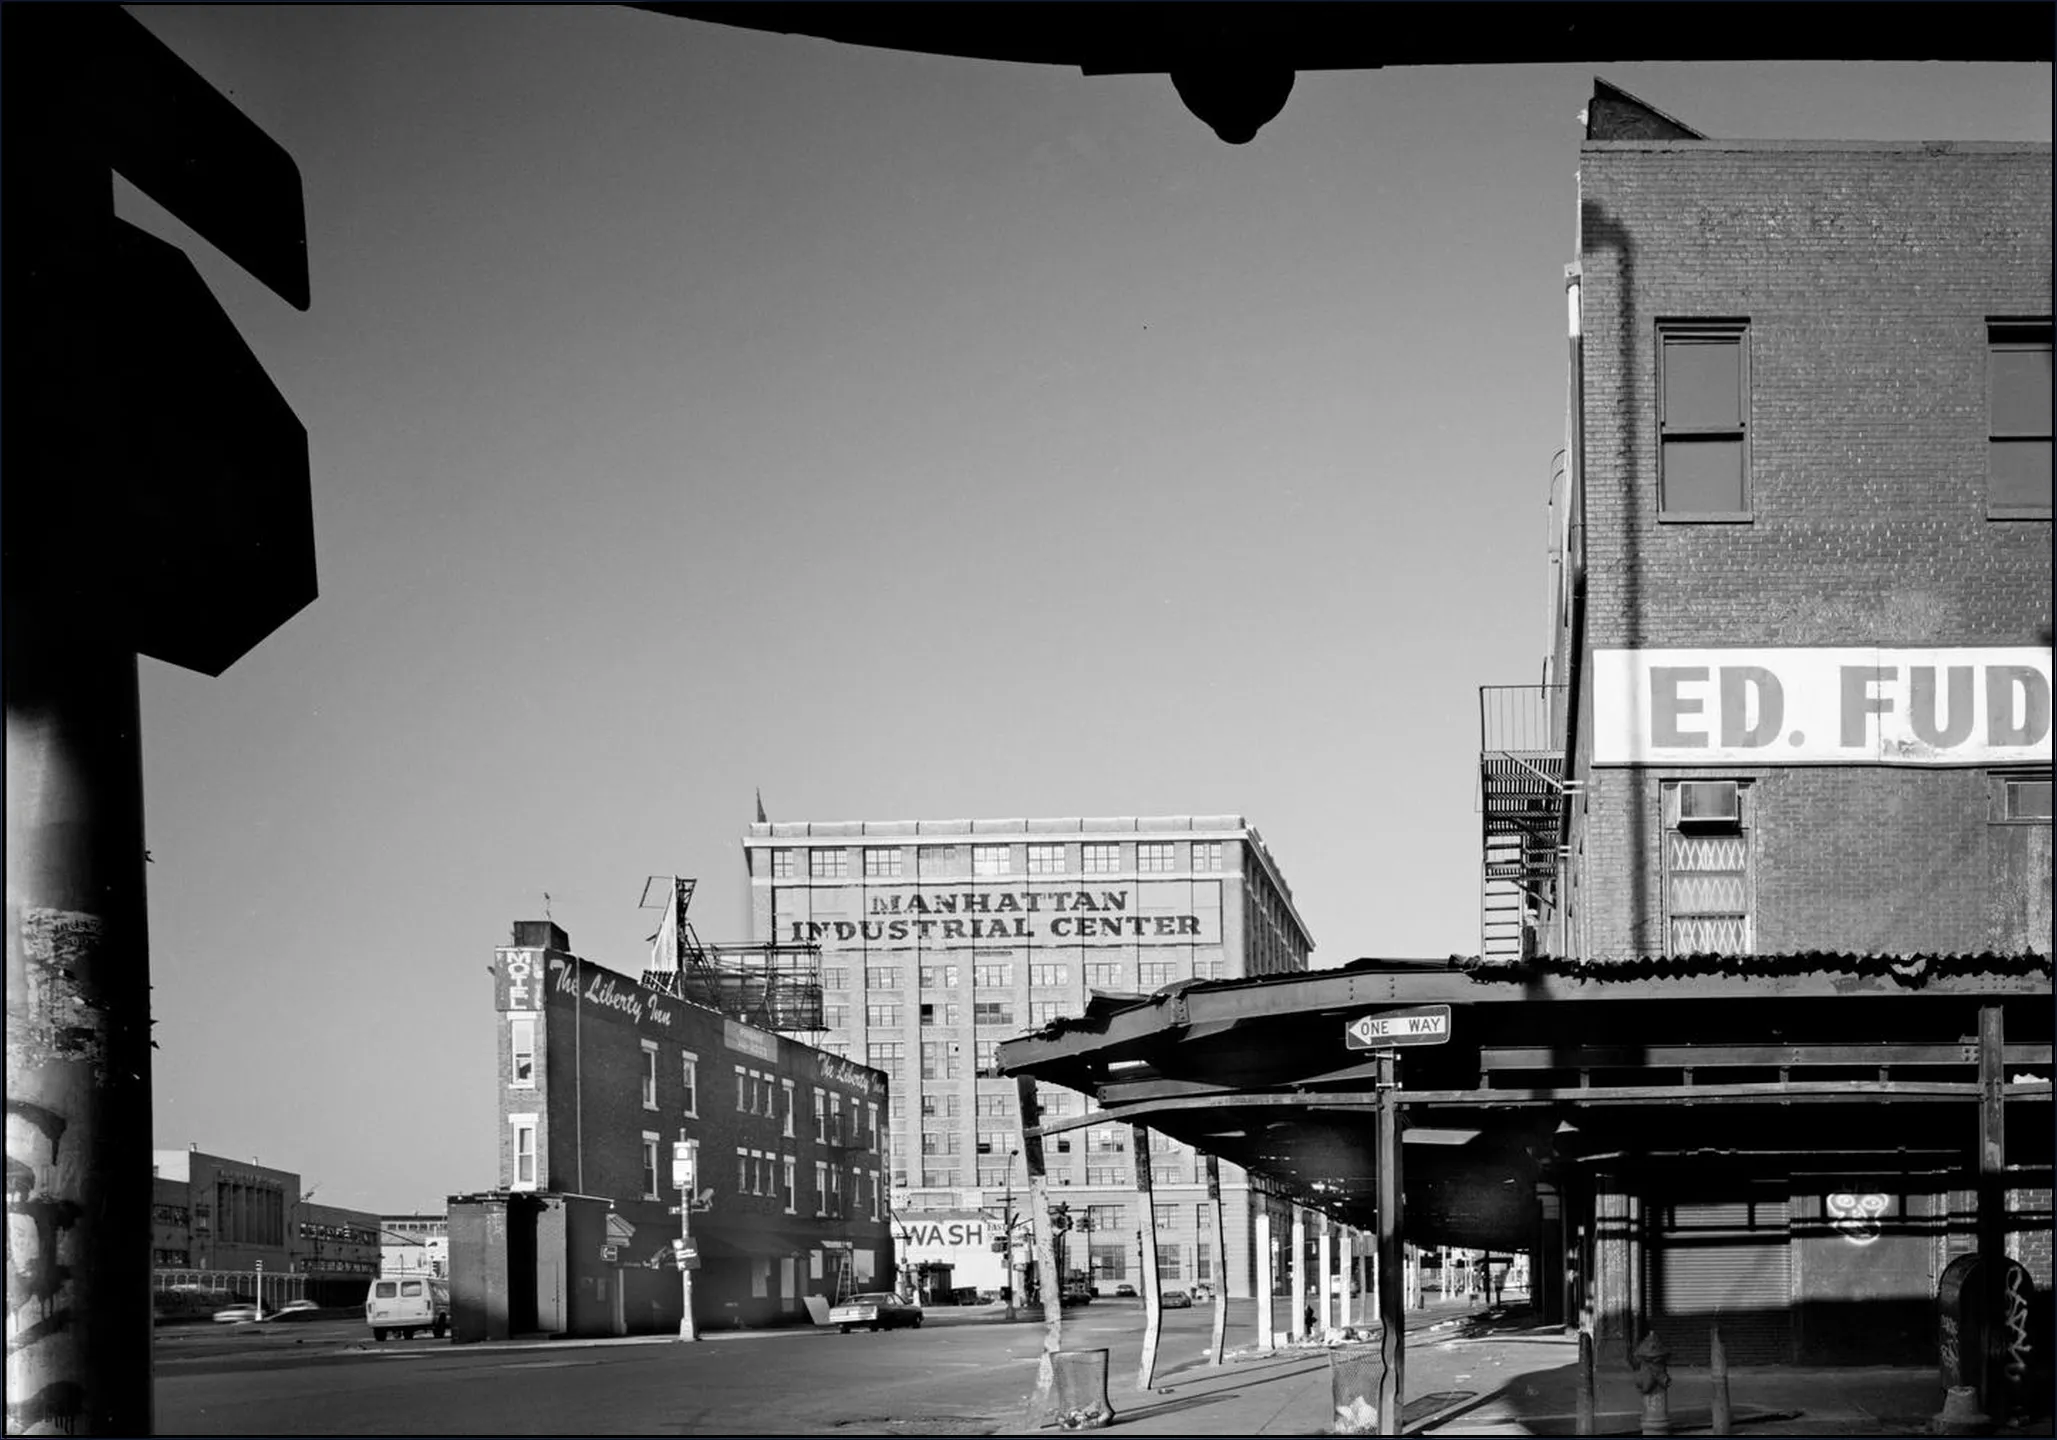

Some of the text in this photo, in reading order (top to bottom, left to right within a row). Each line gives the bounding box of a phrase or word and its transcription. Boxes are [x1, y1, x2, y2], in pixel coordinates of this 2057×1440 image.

[1649, 664, 2052, 749] ED. FUD
[870, 890, 1128, 915] MANHATTAN
[791, 915, 1202, 942] INDUSTRIAL CENTER
[506, 951, 533, 1010] MOTEL
[549, 959, 579, 997] The
[584, 974, 643, 1025] Liberty
[648, 993, 672, 1026] Inn
[1360, 1017, 1441, 1036] ONE WAY
[902, 1223, 983, 1247] WASH
